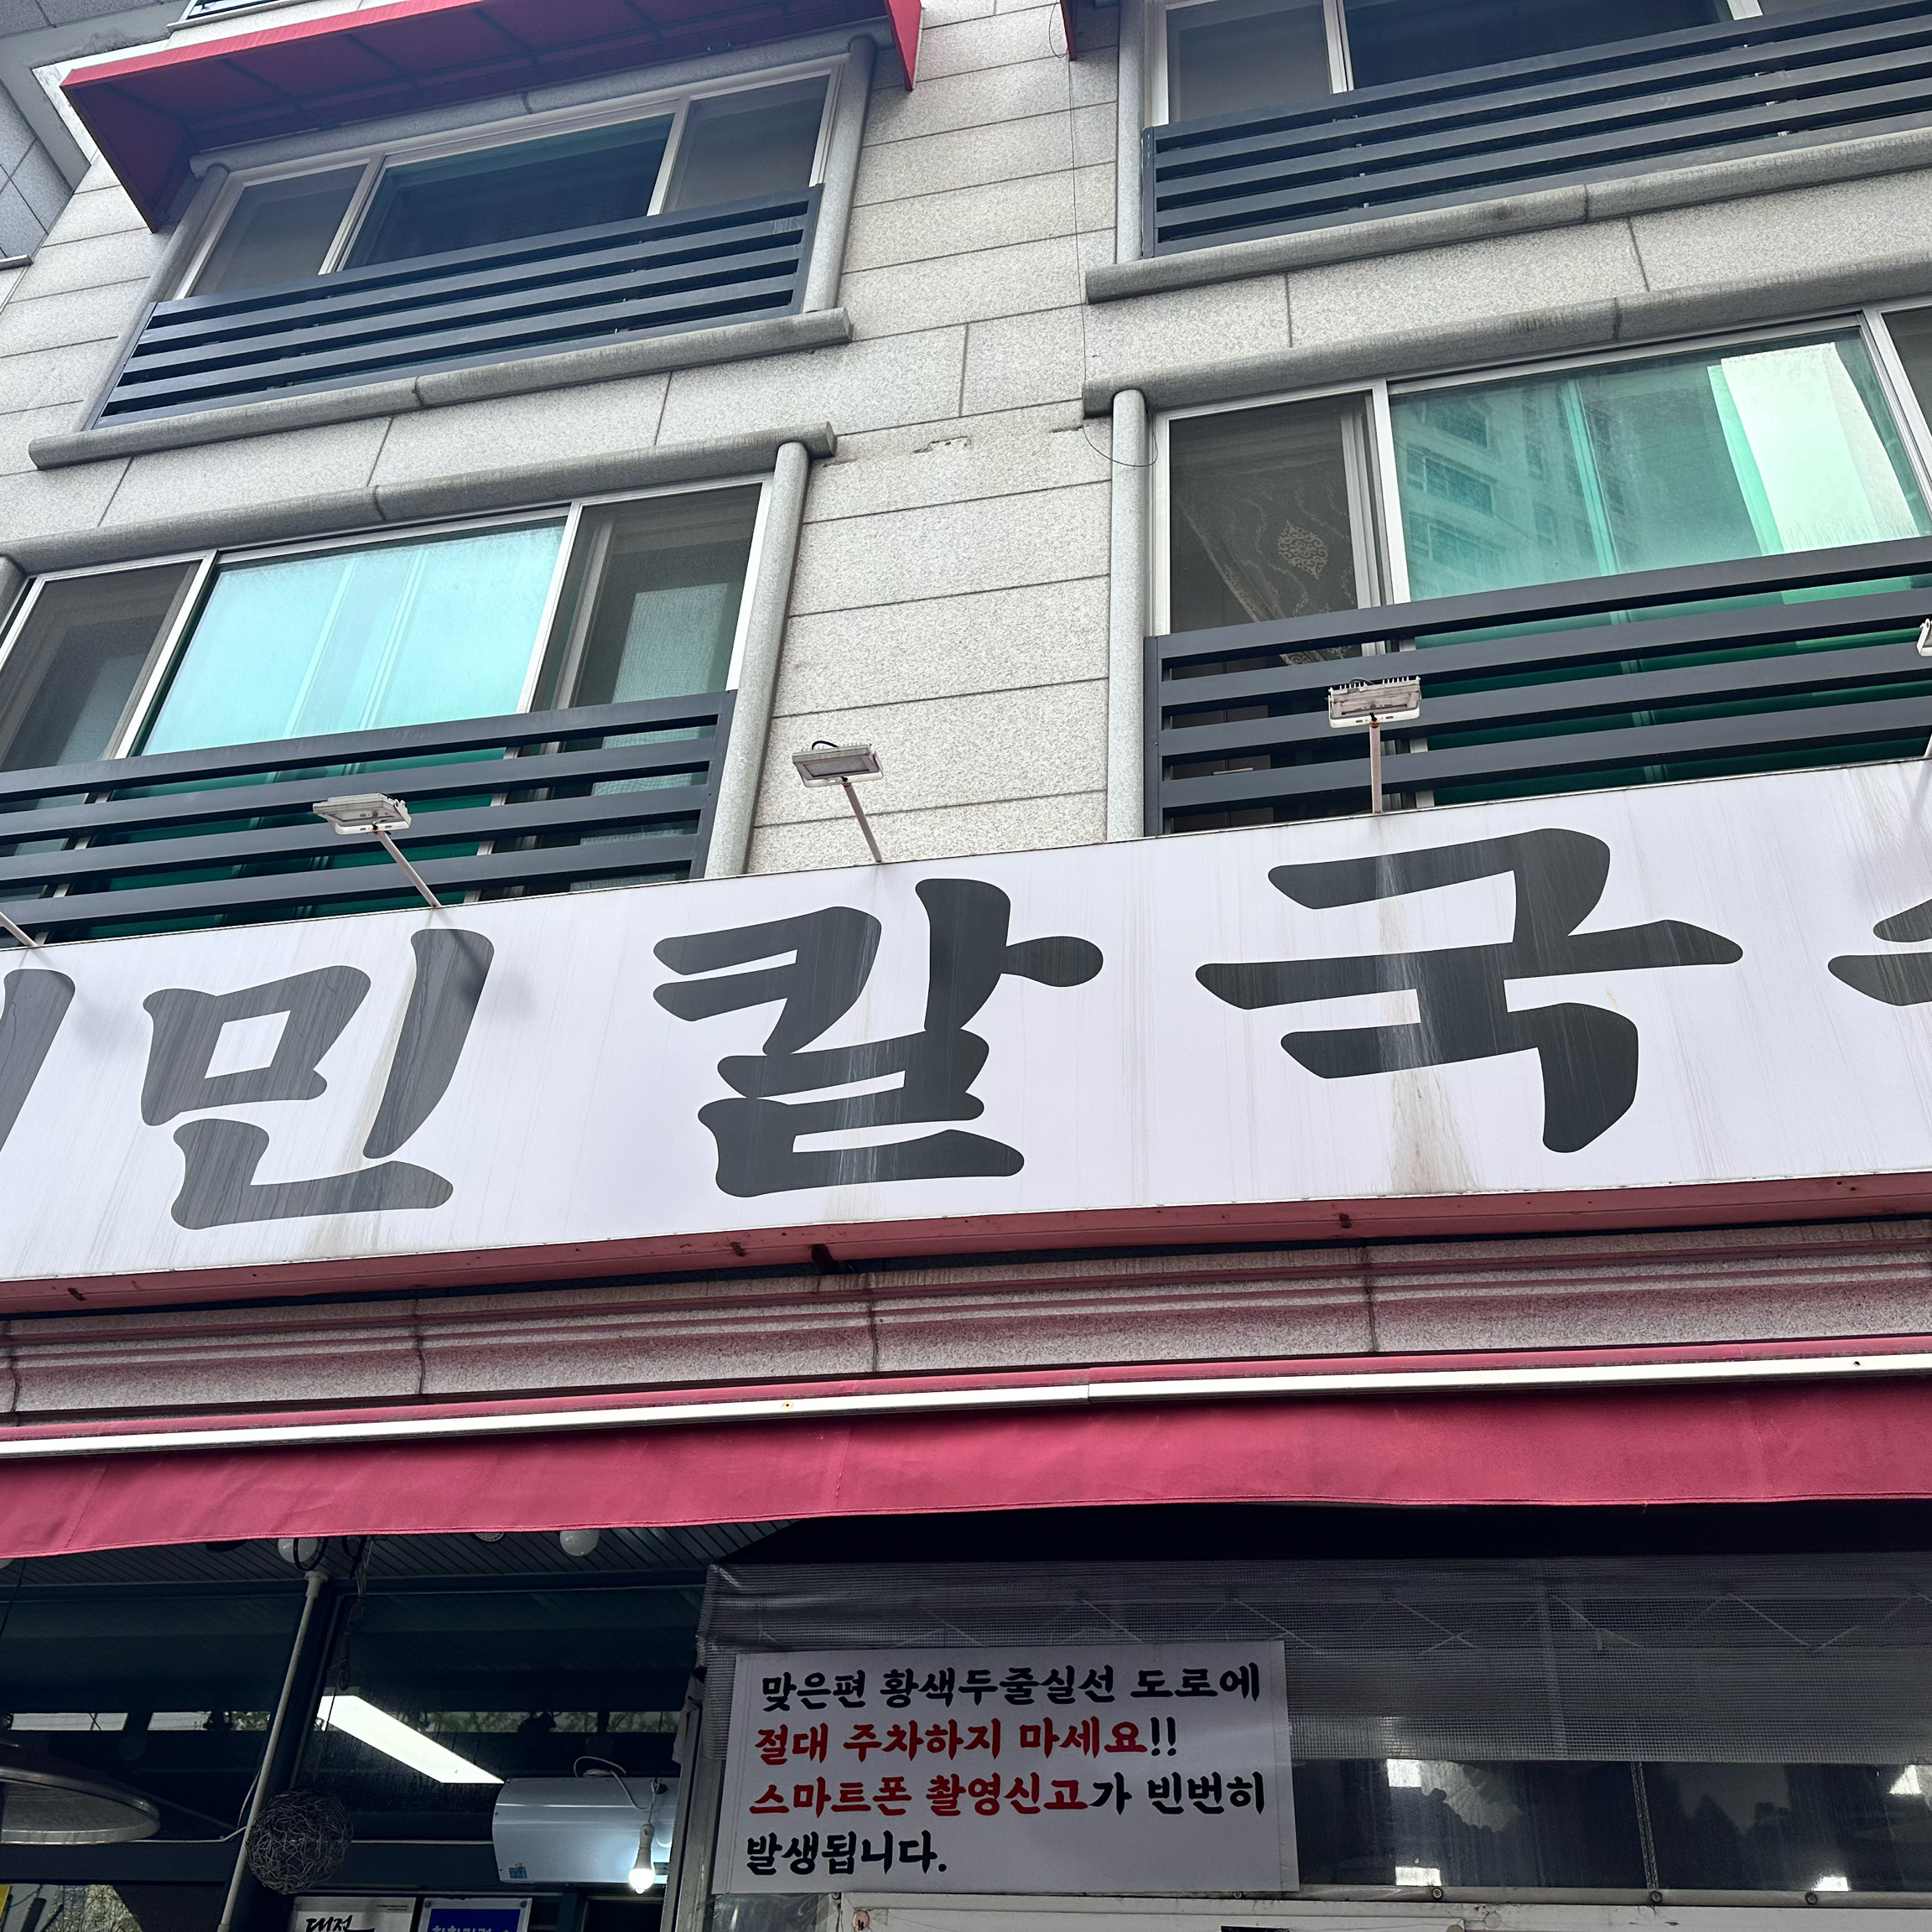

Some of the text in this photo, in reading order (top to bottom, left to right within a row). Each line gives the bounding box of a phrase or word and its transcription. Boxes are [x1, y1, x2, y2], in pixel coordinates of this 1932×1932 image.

[762, 1661, 1260, 1711] 맞은편 황색두줄실선 도로에
[755, 1716, 1177, 1766] 절대 주차하지 마세요!!
[749, 1771, 1265, 1818] 스마트폰 촬영신고가 빈번히
[746, 1831, 948, 1876] 발생됩니다.
